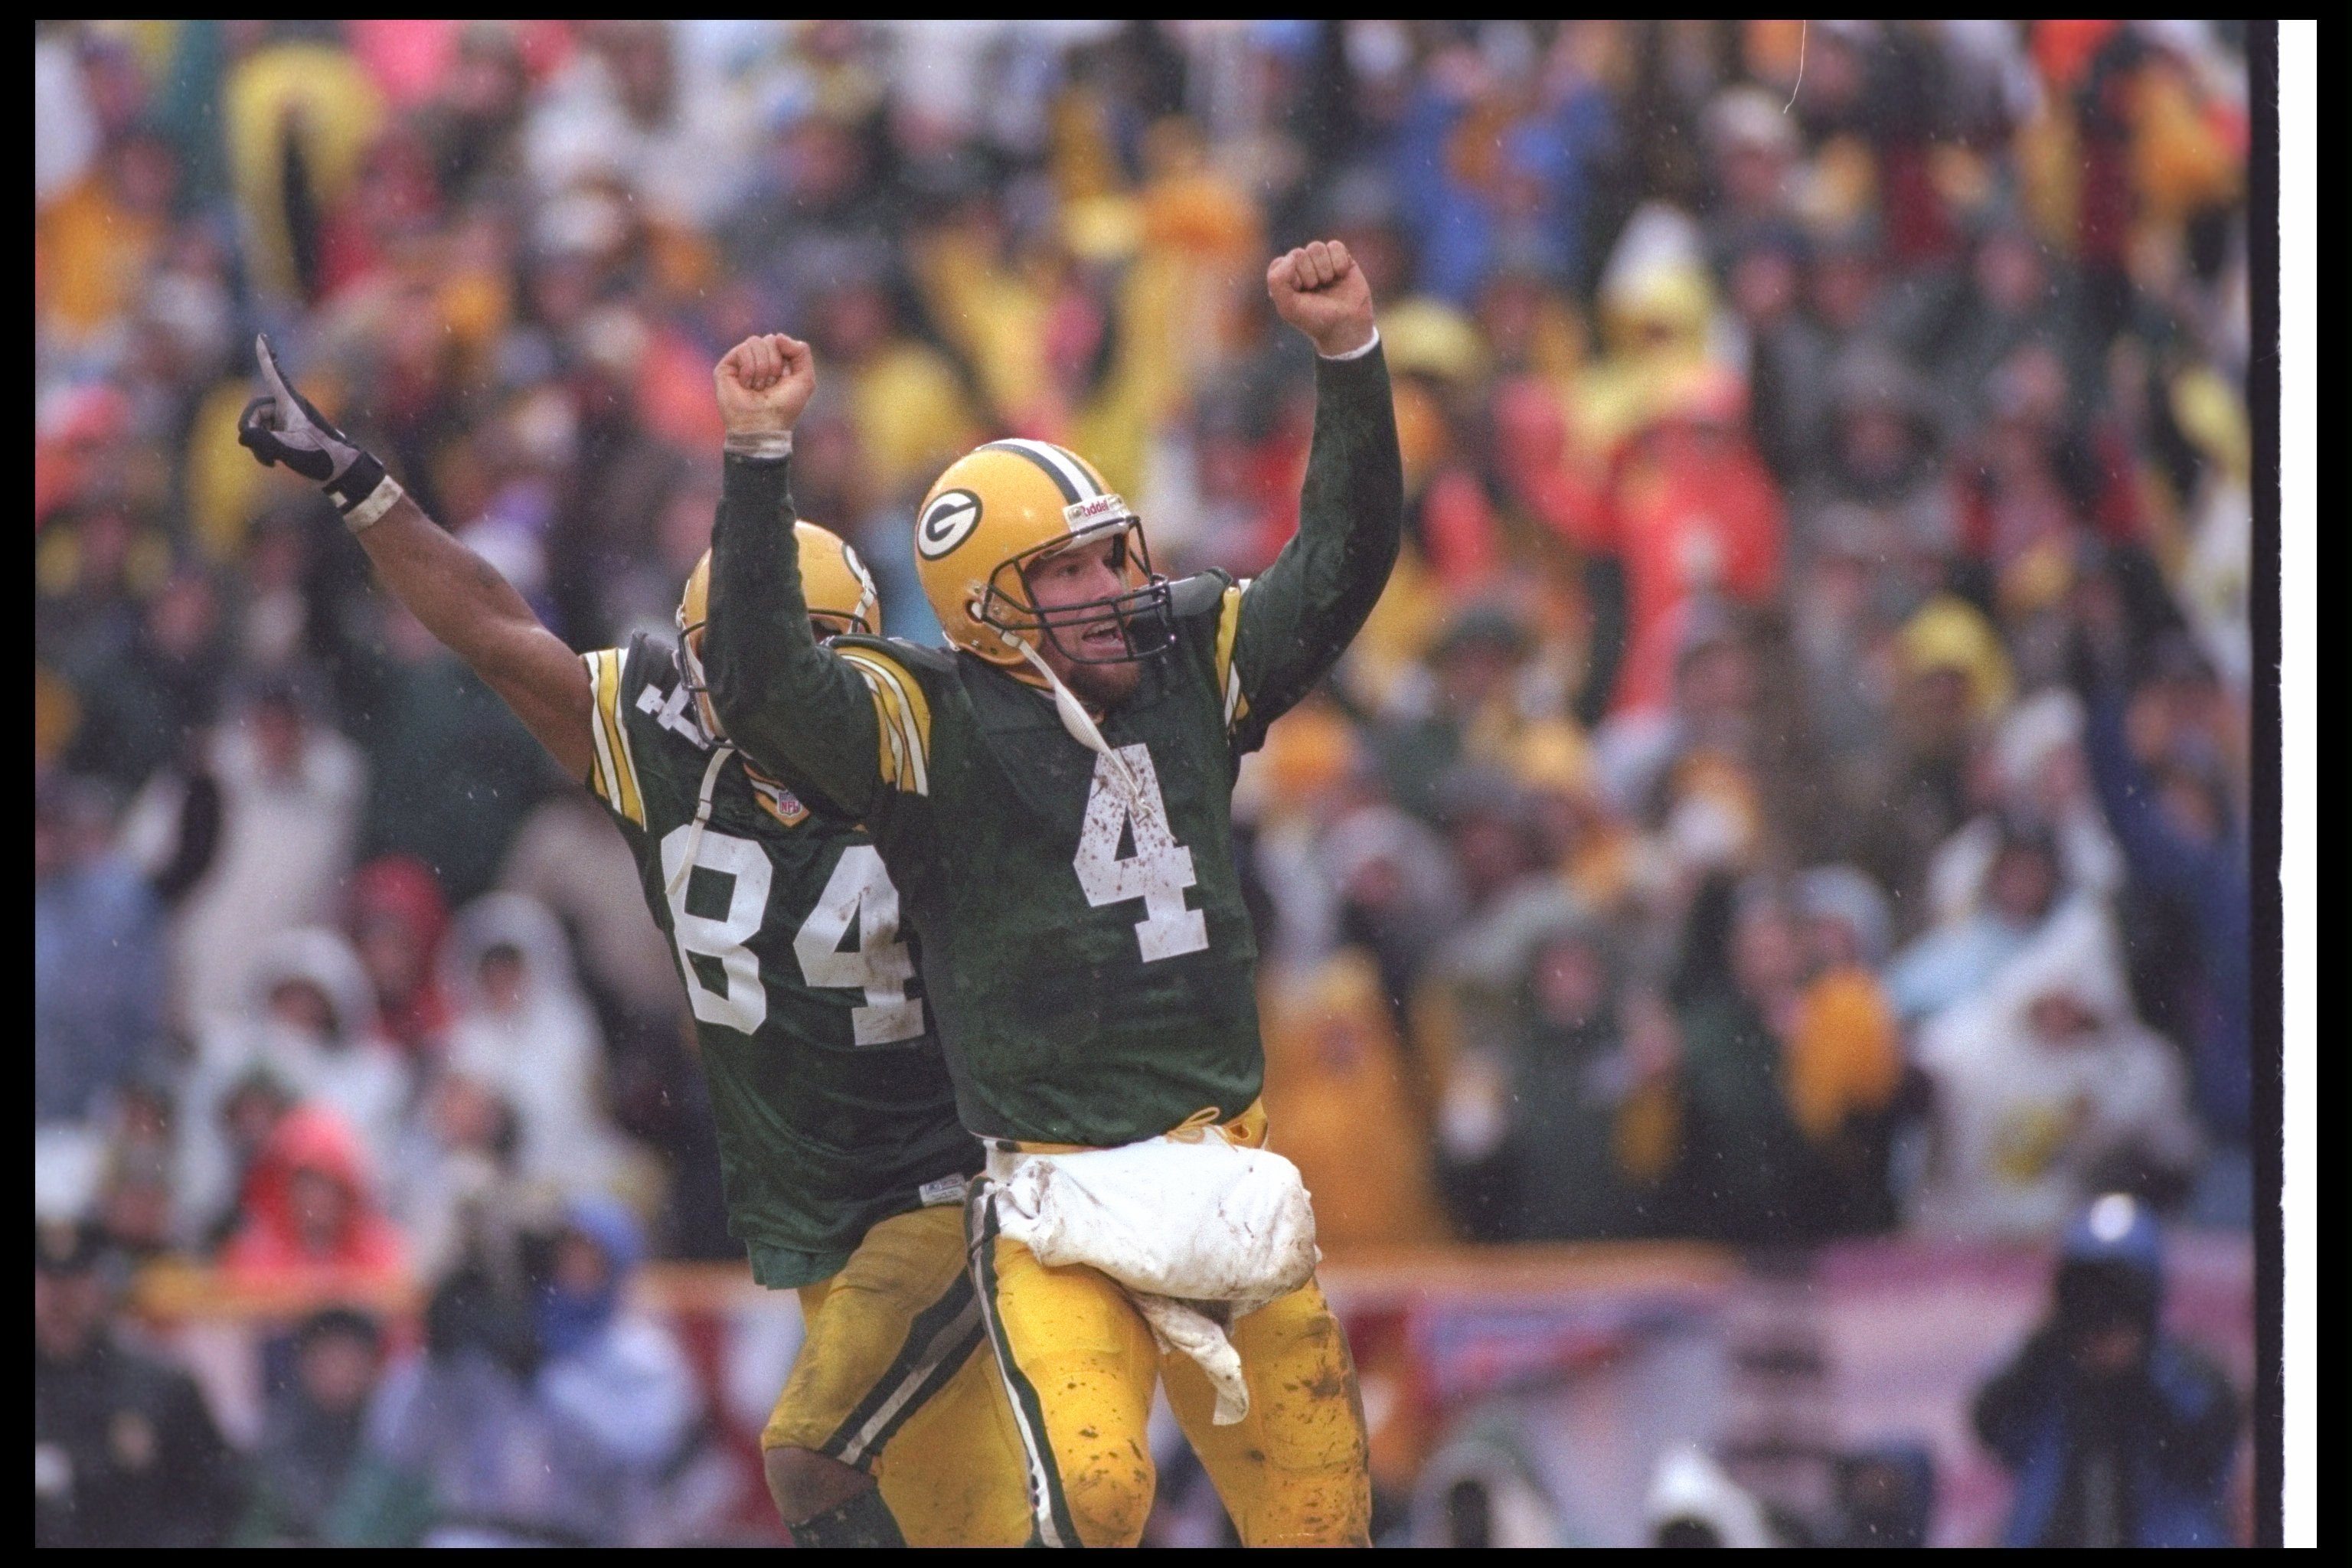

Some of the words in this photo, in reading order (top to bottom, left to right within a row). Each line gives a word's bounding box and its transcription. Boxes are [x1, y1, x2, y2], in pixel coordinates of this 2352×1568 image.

[920, 492, 976, 557] G
[781, 800, 799, 813] NFL
[1073, 743, 1209, 962] 4
[661, 825, 925, 1046] 84
